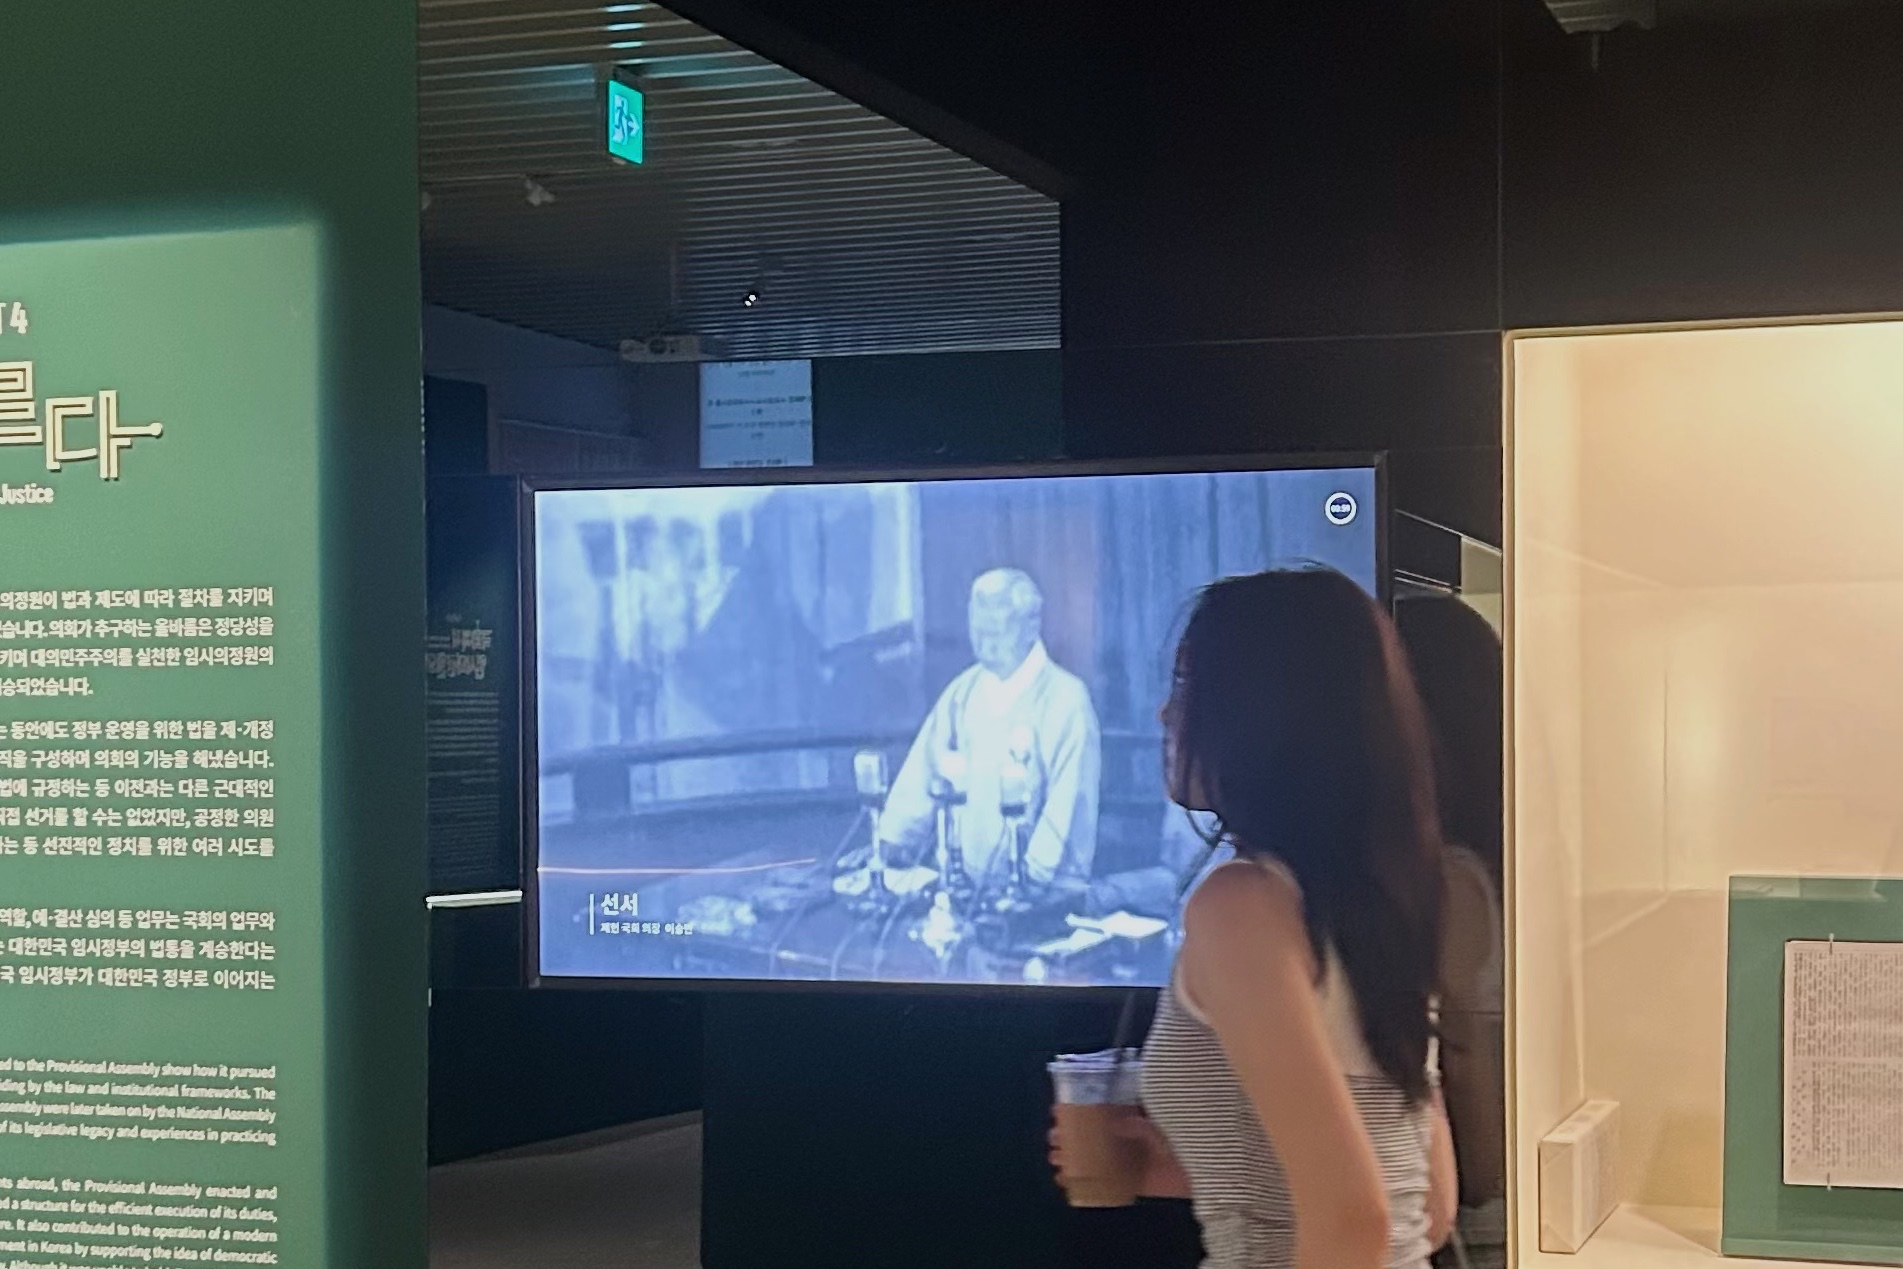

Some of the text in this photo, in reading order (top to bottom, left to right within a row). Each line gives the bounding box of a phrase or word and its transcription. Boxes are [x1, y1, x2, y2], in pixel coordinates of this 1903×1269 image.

[0, 482, 54, 505] Justice
[62, 589, 91, 610] 법과
[95, 589, 140, 609] 제도에
[144, 588, 174, 609] 따라
[178, 587, 223, 608] 절차를
[227, 586, 273, 608] 지키며
[0, 616, 273, 640] 습니다. 의회가 추구하는 올바름은 정당성을
[136, 646, 181, 667] 실천한
[184, 645, 273, 667] 임시의정원의
[10, 720, 217, 740] 동안에도 정부 운영을 위한 법을
[94, 749, 274, 769] 의회의 기능을 해냈습니다.
[31, 778, 90, 798] 규정하는
[94, 778, 110, 798] 등
[114, 778, 174, 798] 이전과는
[179, 778, 209, 798] 다른
[213, 778, 273, 798] 근대적인
[25, 806, 68, 827] 선거를
[73, 806, 88, 827] 할
[92, 807, 122, 827] 수는
[193, 807, 239, 828] 공정한
[243, 808, 273, 828] 의원
[23, 835, 274, 857] 등 선진적인 정치를 위한 여러 시도를
[600, 892, 639, 917] 선서
[86, 908, 275, 931] 심의 등 업무는 국회의 업무와
[8, 936, 67, 957] 대한민국
[71, 937, 145, 958] 임시정부의
[150, 939, 195, 959] 법통을
[199, 940, 275, 961] 계승한다는
[19, 965, 275, 990] 임시정부가 대한민국 정부로 이어지는
[26, 1058, 276, 1081] the Provisional Assembly show how pursued
[44, 1079, 276, 1101] the law and institutional frameworks. The
[43, 1101, 276, 1125] were later taken by the National Assembly
[24, 1120, 78, 1138] legislative
[80, 1122, 115, 1141] legacy
[116, 1124, 138, 1139] and
[140, 1126, 205, 1142] experiences
[16, 1176, 277, 1200] abroad, the Provisional Assembly enacted and
[20, 1198, 277, 1224] structure for the efficient execution duties,
[27, 1218, 277, 1243] also contributed the operation modern
[41, 1240, 278, 1265] Korea by supporting the idea democratic
